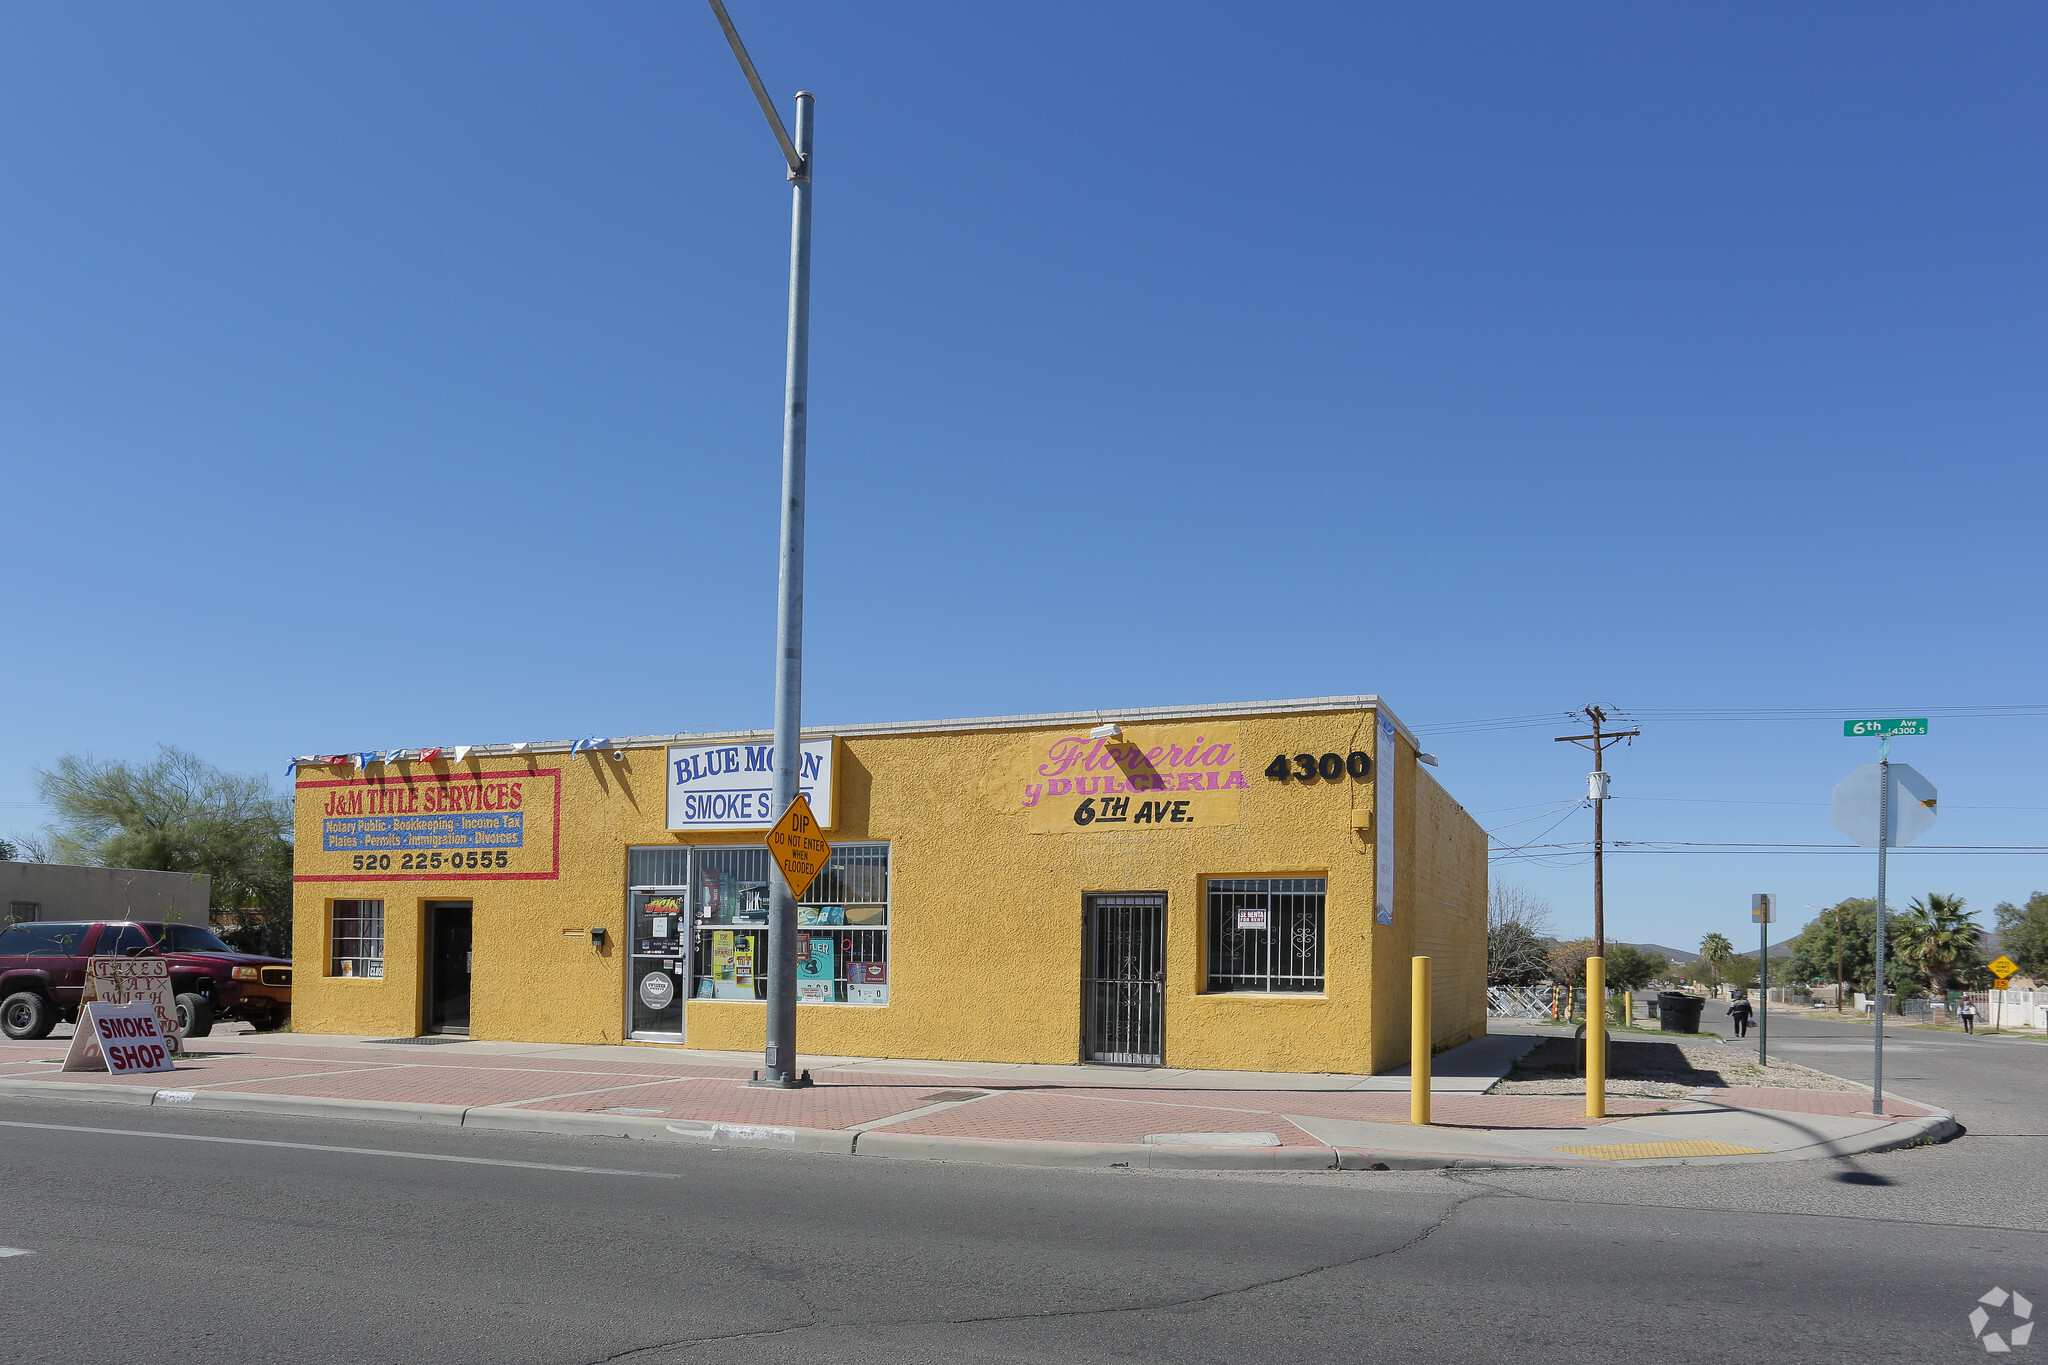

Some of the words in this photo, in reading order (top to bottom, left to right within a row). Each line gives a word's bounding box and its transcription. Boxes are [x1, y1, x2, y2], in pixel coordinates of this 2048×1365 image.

[1853, 722, 1881, 734] 6th
[674, 747, 739, 786] BLUE
[744, 746, 823, 781] MN
[1038, 736, 1236, 777] Floreria
[1264, 751, 1370, 781] 4300
[1047, 770, 1250, 796] DULCERIA
[324, 790, 363, 816] J&M
[367, 787, 419, 814] TITLE
[423, 782, 523, 812] SERVICES
[685, 794, 752, 819] SMOKE
[1073, 796, 1130, 826] 6TH
[1134, 800, 1194, 824] AVE.
[326, 820, 356, 835] Notary
[358, 819, 386, 832] Public
[393, 817, 455, 833] Bookkeeping
[462, 816, 499, 829] Income
[501, 815, 521, 828] Tax
[792, 813, 810, 834] DIP
[329, 834, 357, 847] Plates
[364, 833, 401, 847] Permits
[409, 832, 467, 848] Immigration
[474, 832, 518, 844] Divorces
[774, 832, 785, 845] DO
[787, 833, 801, 848] NOT
[803, 837, 825, 853] ENTER
[353, 855, 391, 870] 520
[401, 851, 508, 870] 225-0555
[792, 850, 808, 861] WHEN
[784, 859, 815, 876] FLOODED
[98, 962, 164, 976] TAXES
[111, 977, 155, 991] PAY
[103, 991, 164, 1004] WITH
[98, 1018, 158, 1039] SMOKE
[109, 1045, 165, 1070] SHOP
